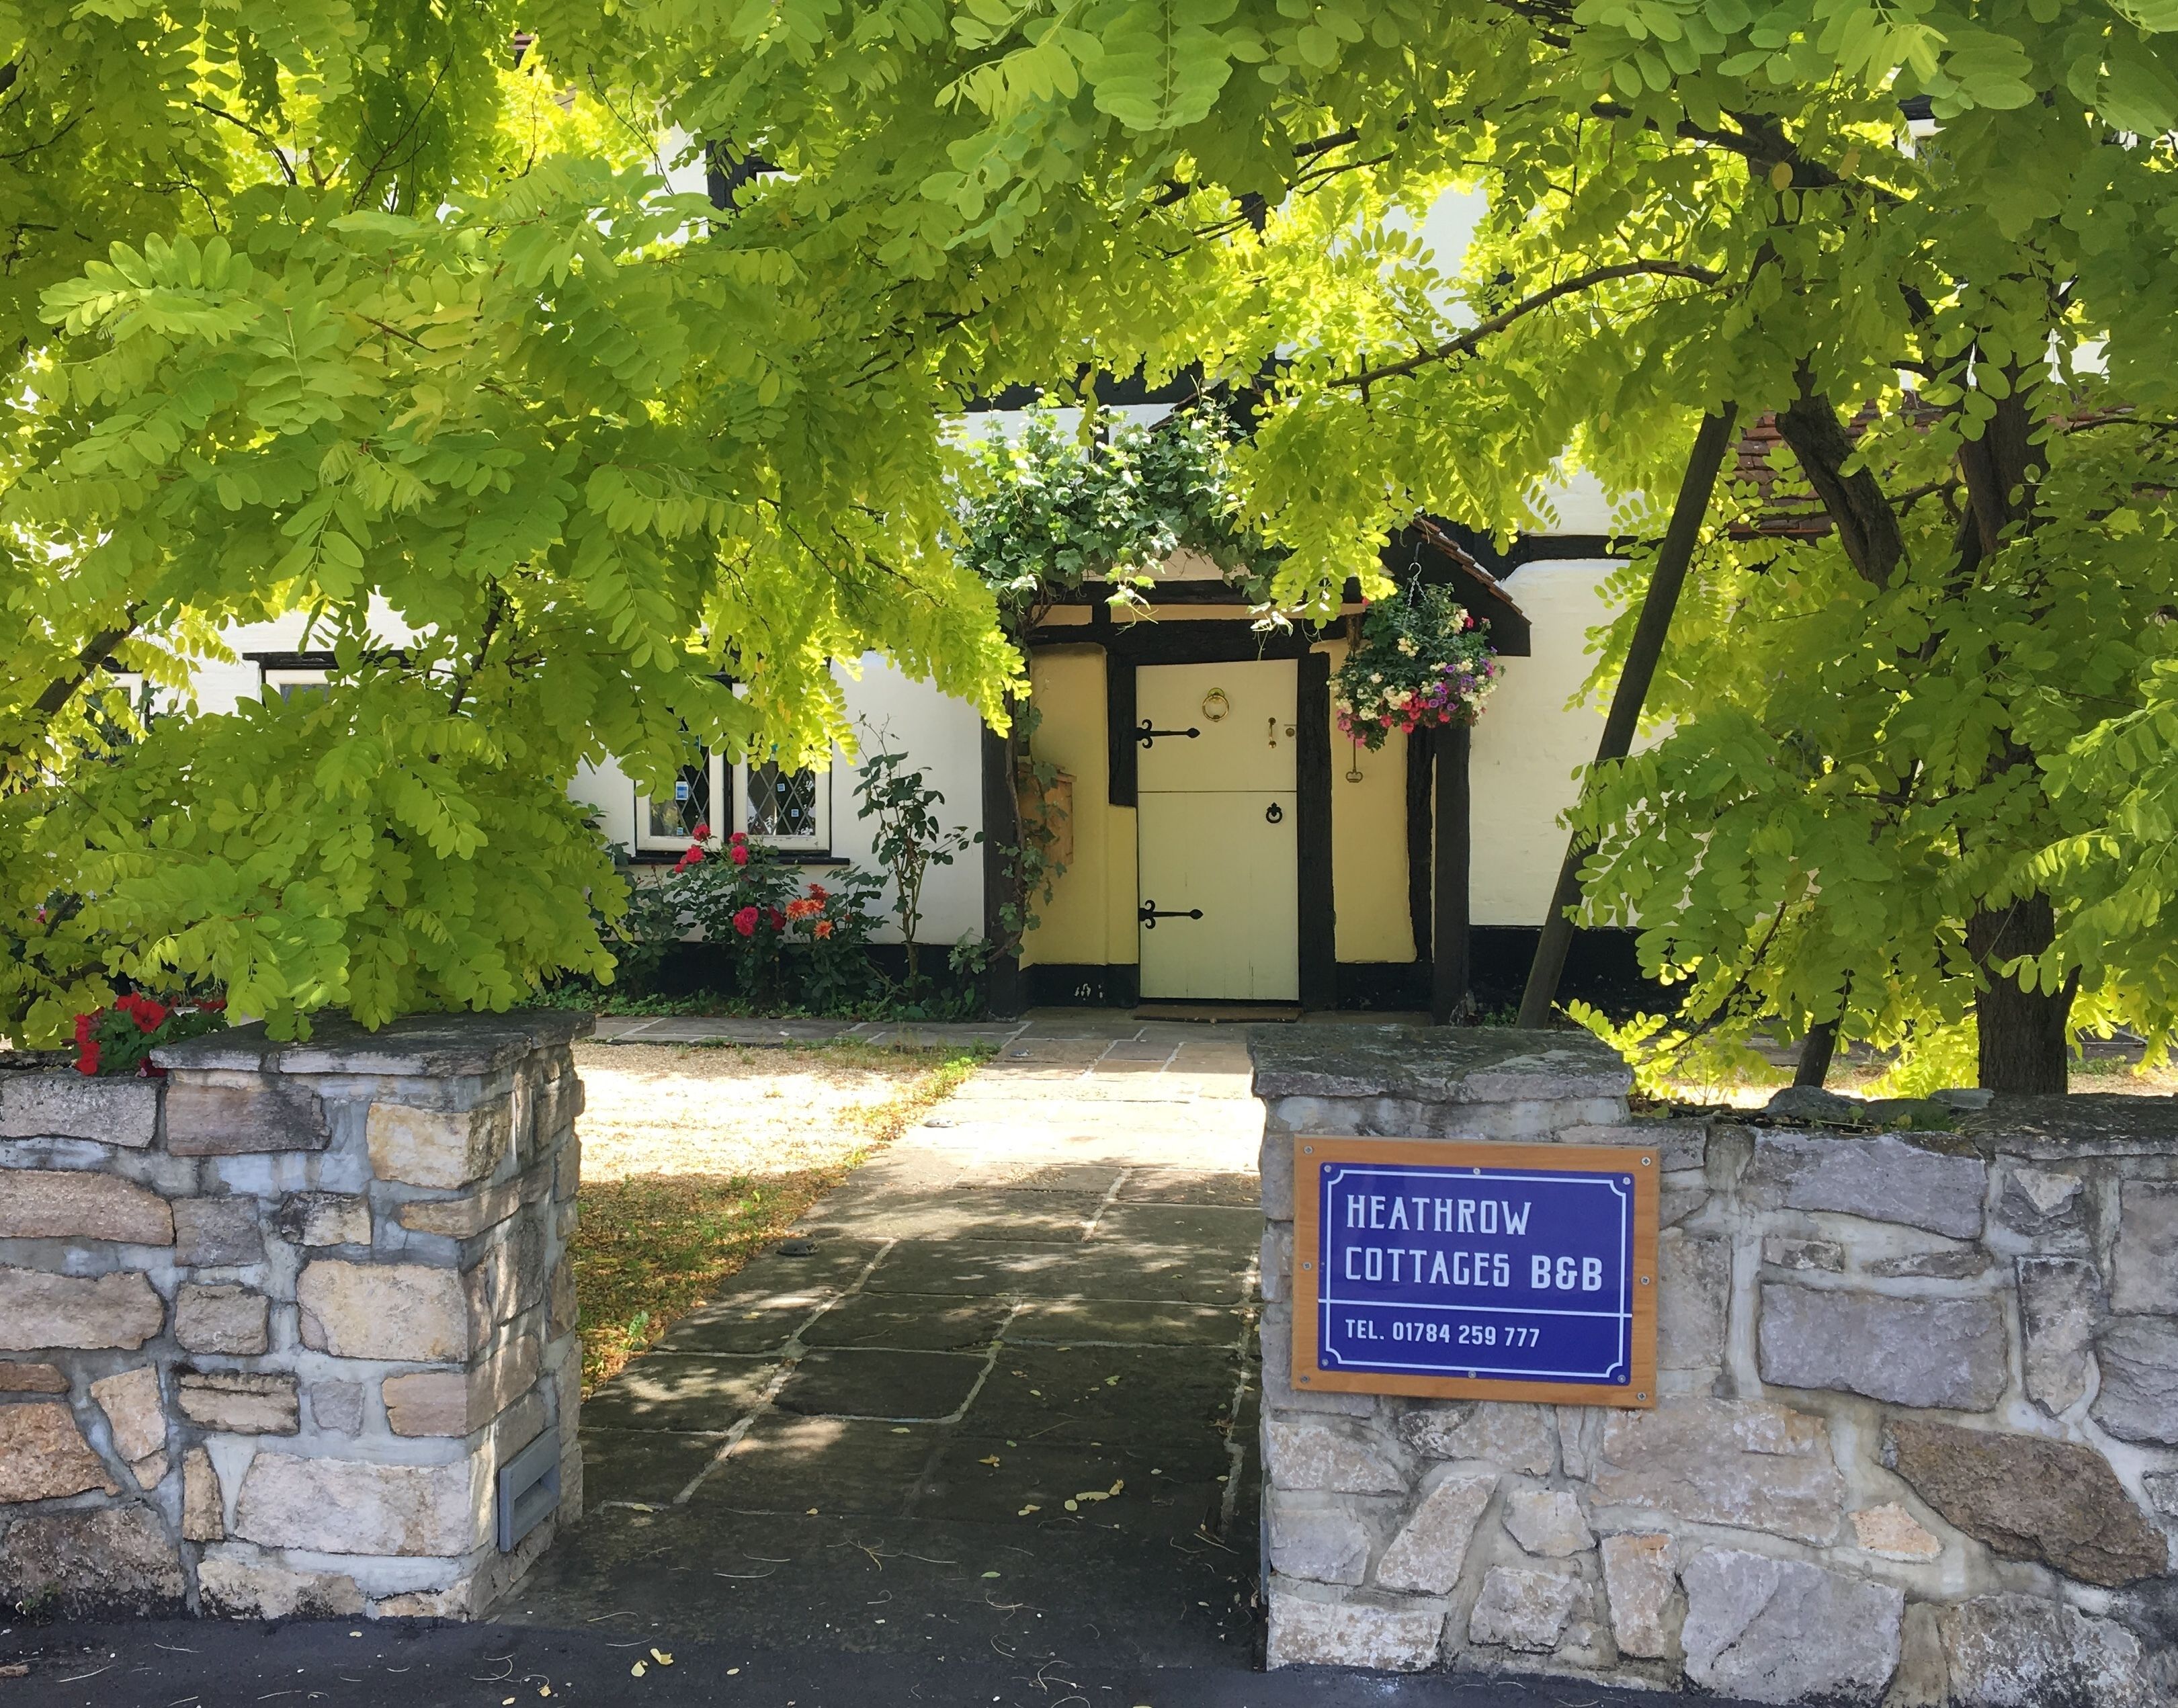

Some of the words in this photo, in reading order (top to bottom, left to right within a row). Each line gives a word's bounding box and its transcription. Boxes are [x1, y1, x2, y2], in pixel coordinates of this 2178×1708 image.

[1346, 1194, 1532, 1236] HEATHROW
[1345, 1246, 1510, 1288] COTTAGES
[1530, 1254, 1603, 1291] B&B
[1345, 1319, 1385, 1340] TEL.
[1392, 1322, 1450, 1343] 01784
[1458, 1325, 1497, 1346] 259
[1505, 1327, 1540, 1347] 777
